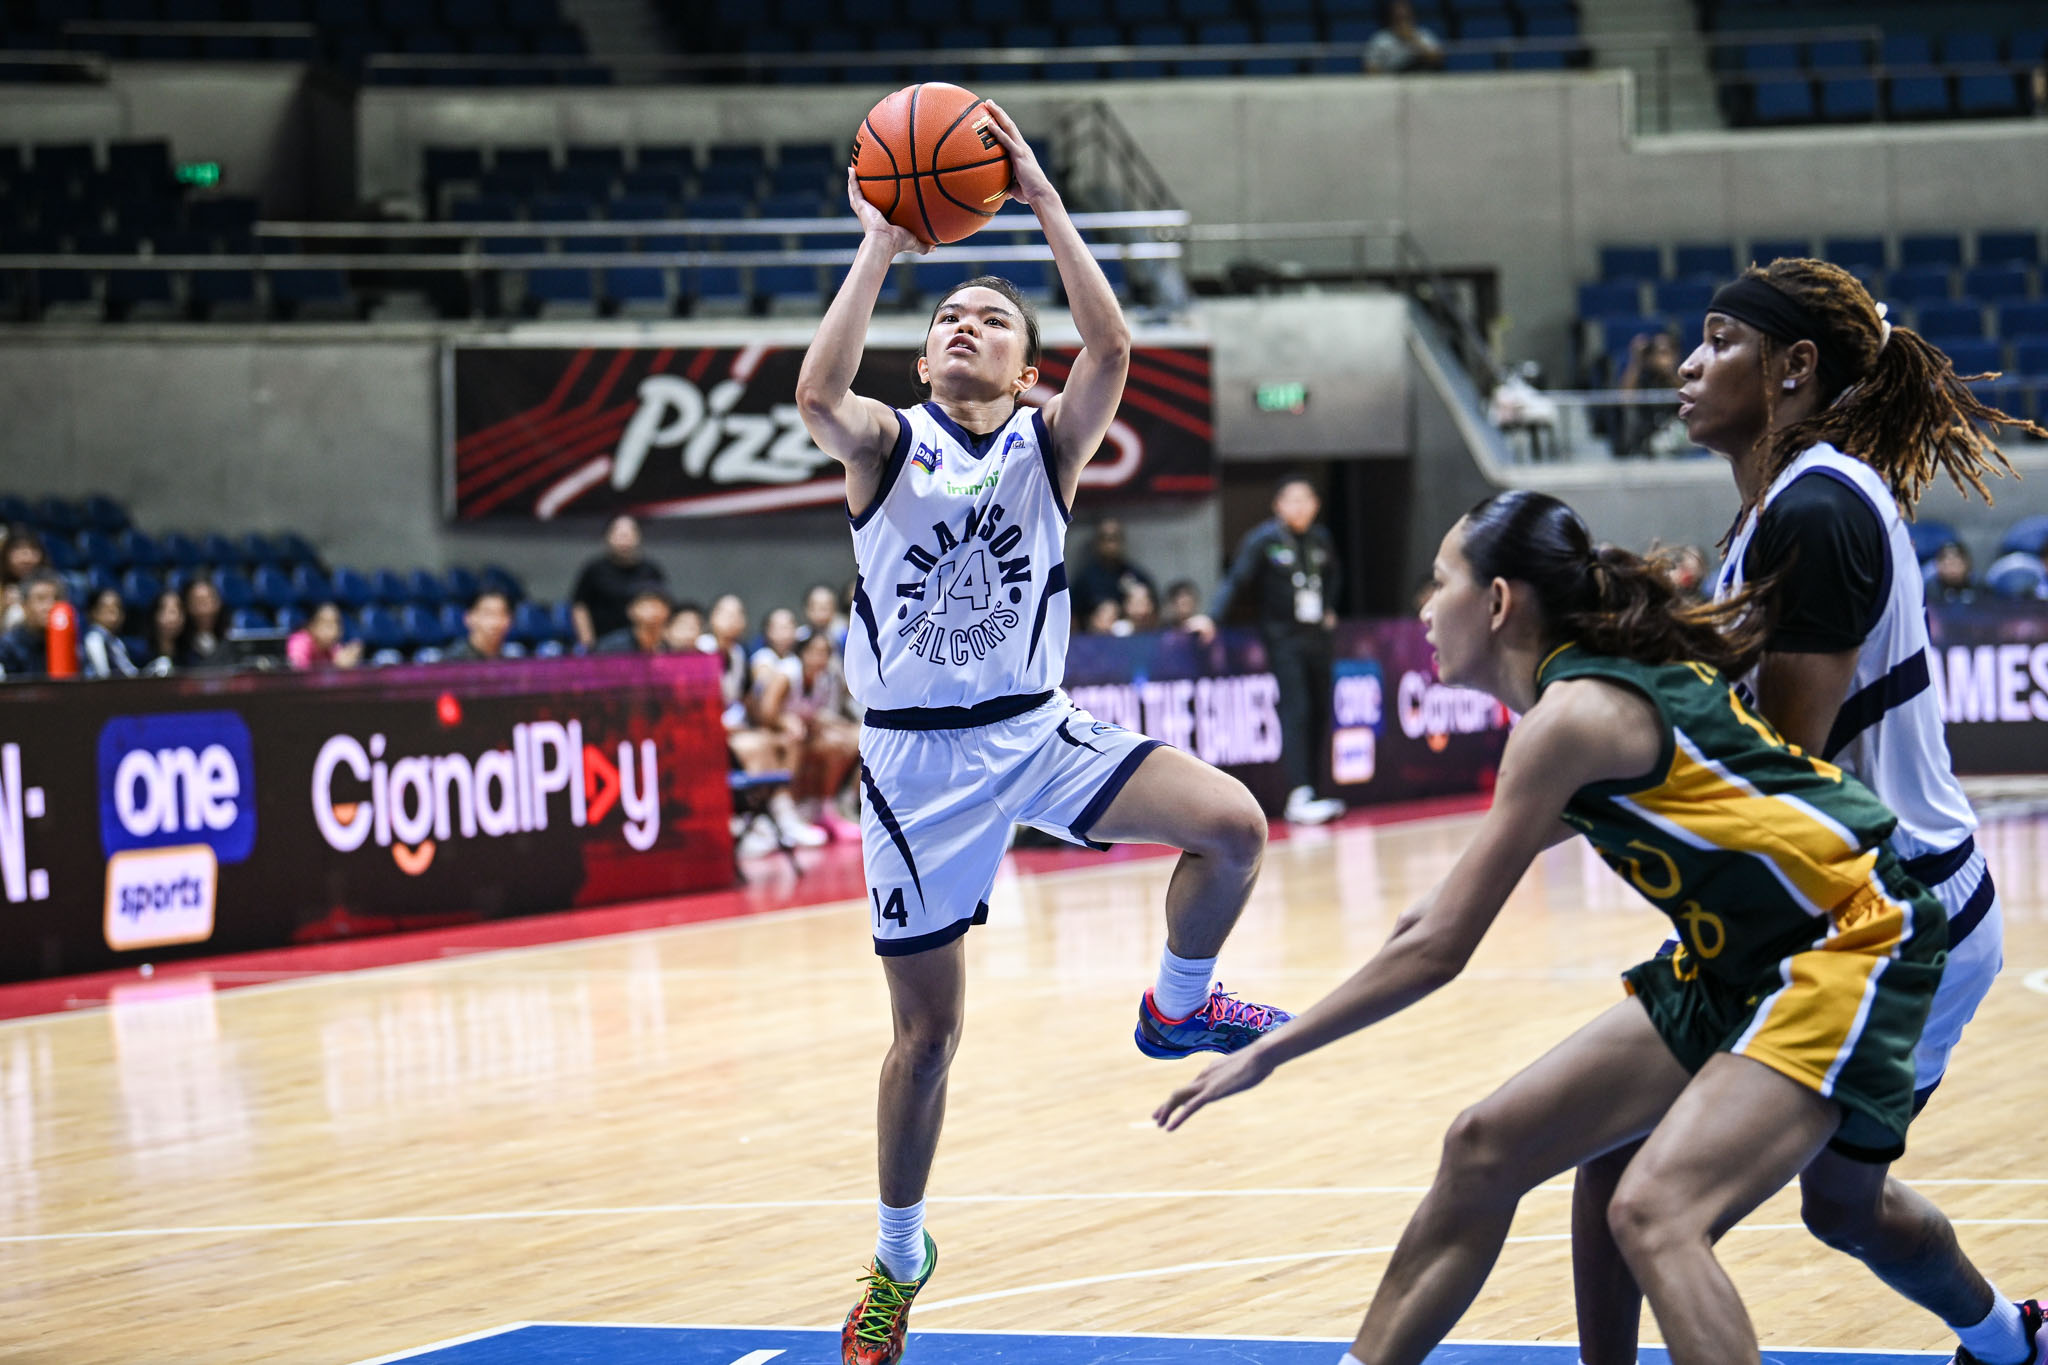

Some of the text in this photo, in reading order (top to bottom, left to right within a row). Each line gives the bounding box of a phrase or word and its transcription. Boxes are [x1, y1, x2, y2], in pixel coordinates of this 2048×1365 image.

[612, 374, 834, 491] Pizz
[932, 550, 991, 616] 14
[898, 600, 1019, 666] FALCONS
[113, 743, 240, 837] one
[119, 876, 201, 923] sports
[872, 887, 909, 928] 14
